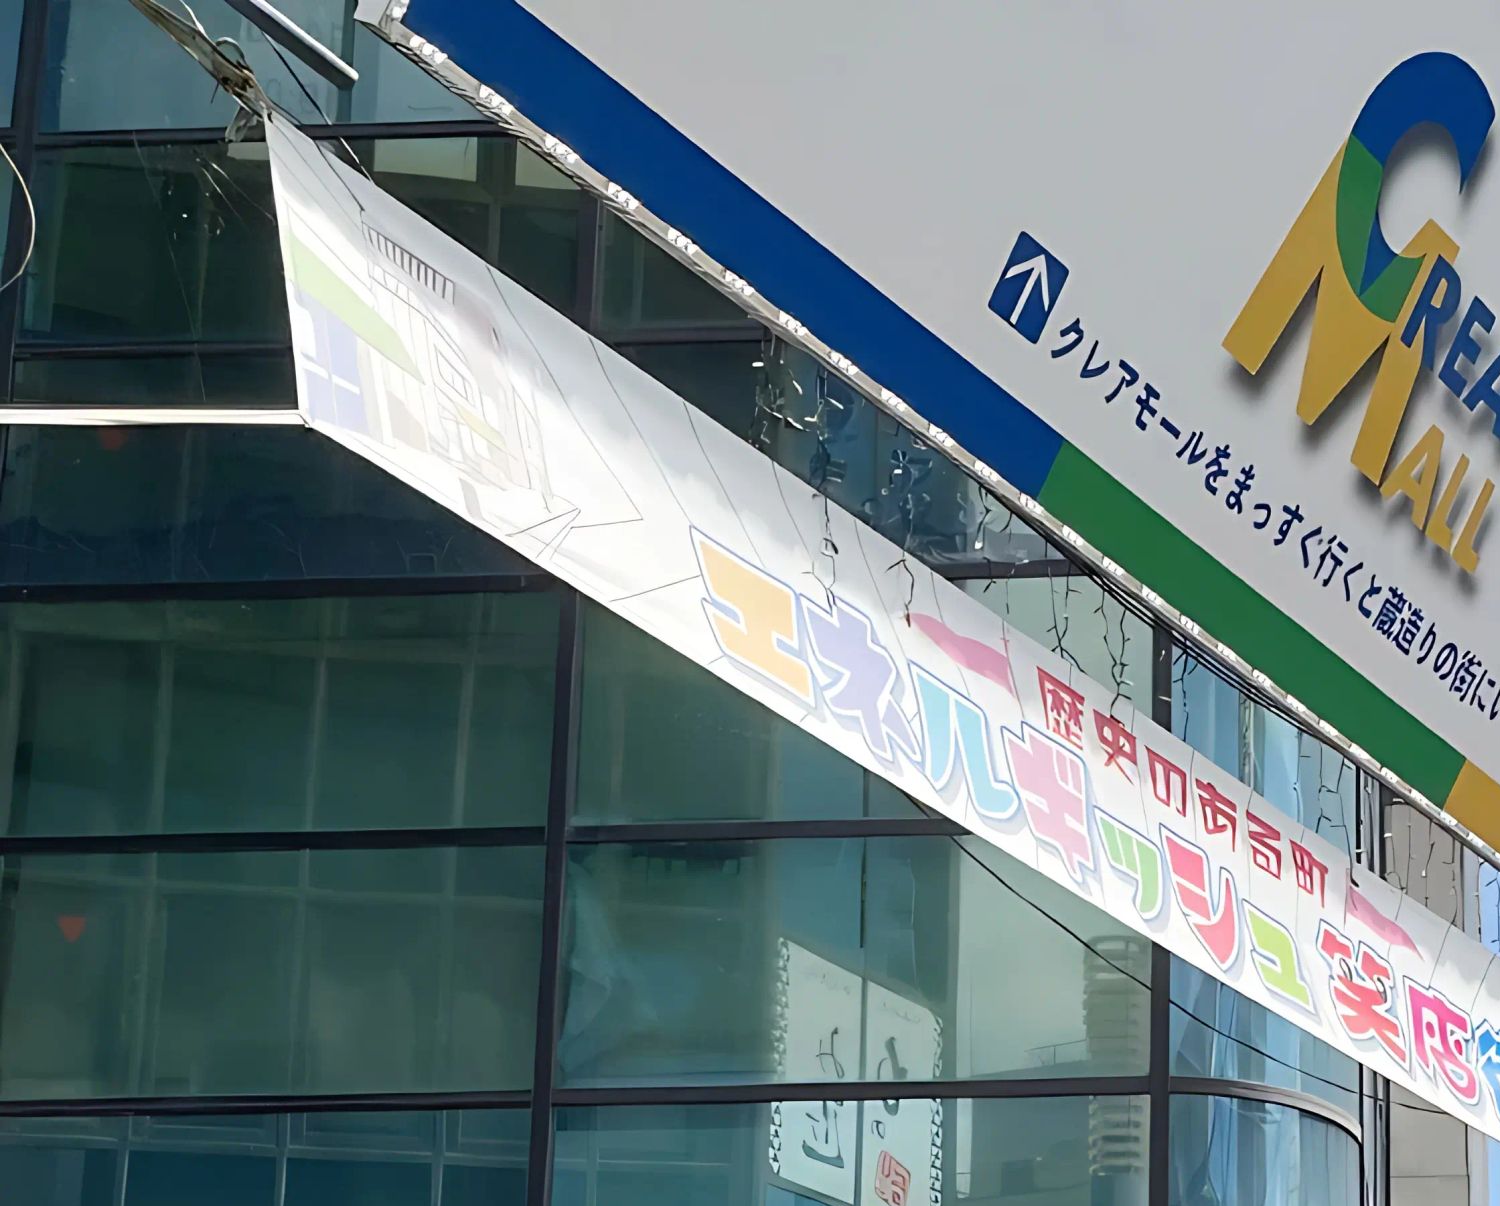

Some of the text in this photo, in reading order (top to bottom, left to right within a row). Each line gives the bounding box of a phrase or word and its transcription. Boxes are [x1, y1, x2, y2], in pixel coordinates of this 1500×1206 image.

[1037, 665, 1330, 908] 歴史のある町
